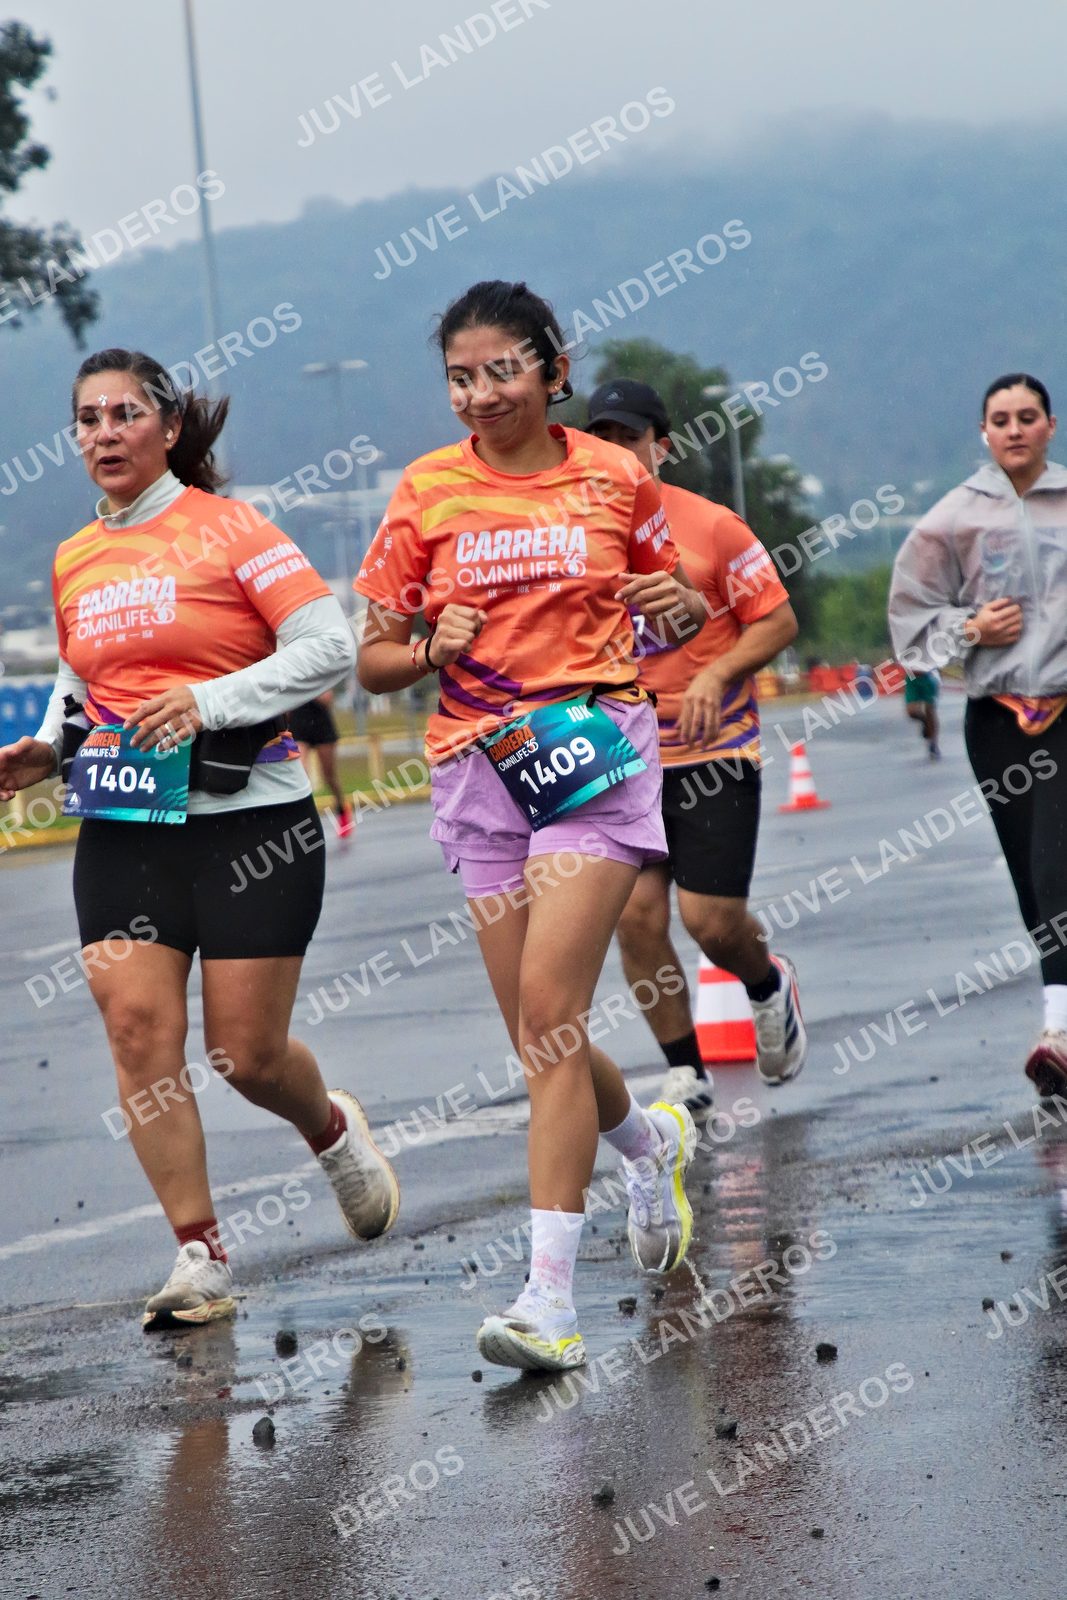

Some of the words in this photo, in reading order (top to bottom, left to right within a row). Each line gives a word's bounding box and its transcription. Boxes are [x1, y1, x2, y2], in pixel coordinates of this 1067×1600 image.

[456, 525, 587, 564] CARRERA
[456, 560, 559, 587] OMNILIFE
[77, 575, 176, 621] CARRERA
[76, 608, 150, 640] OMNILIFE
[565, 704, 595, 723] 10K
[489, 725, 535, 762] CARRERA
[498, 747, 530, 772] OMNILIFE
[86, 764, 157, 794] 1404
[519, 736, 596, 795] 1409
